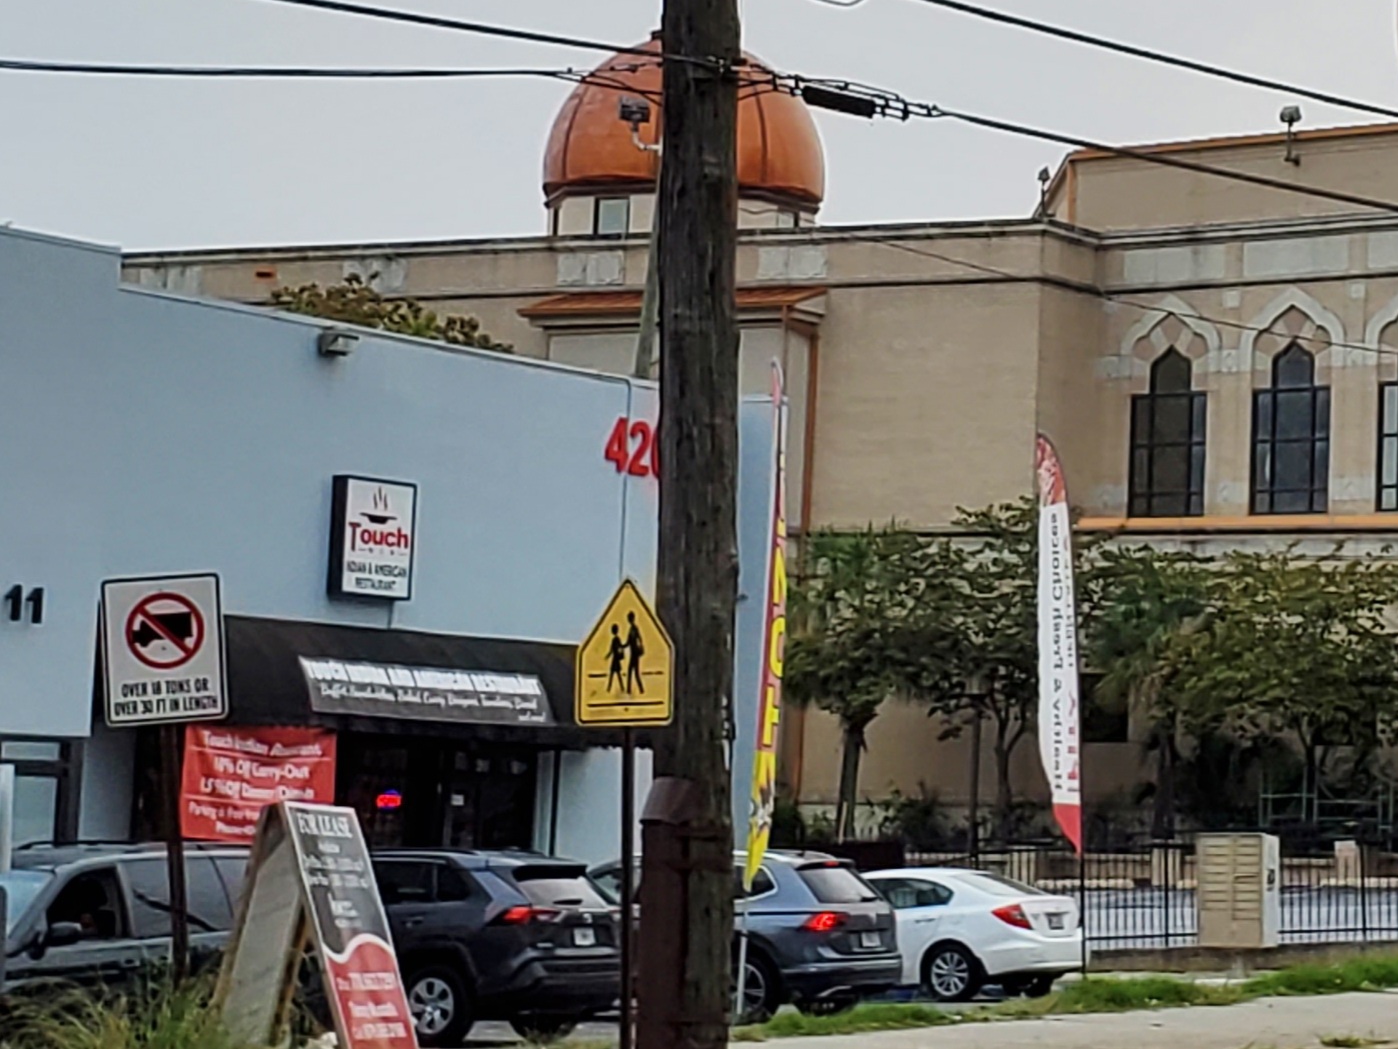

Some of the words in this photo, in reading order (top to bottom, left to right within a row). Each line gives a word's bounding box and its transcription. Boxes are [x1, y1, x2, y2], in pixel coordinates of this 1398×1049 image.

[348, 521, 409, 552] Touch
[4, 584, 44, 624] 11
[122, 682, 148, 698] OVER
[165, 678, 191, 694] TONS
[194, 677, 208, 692] OR
[114, 700, 138, 716] OVER
[170, 697, 179, 712] IN
[183, 695, 218, 711] LENGTH
